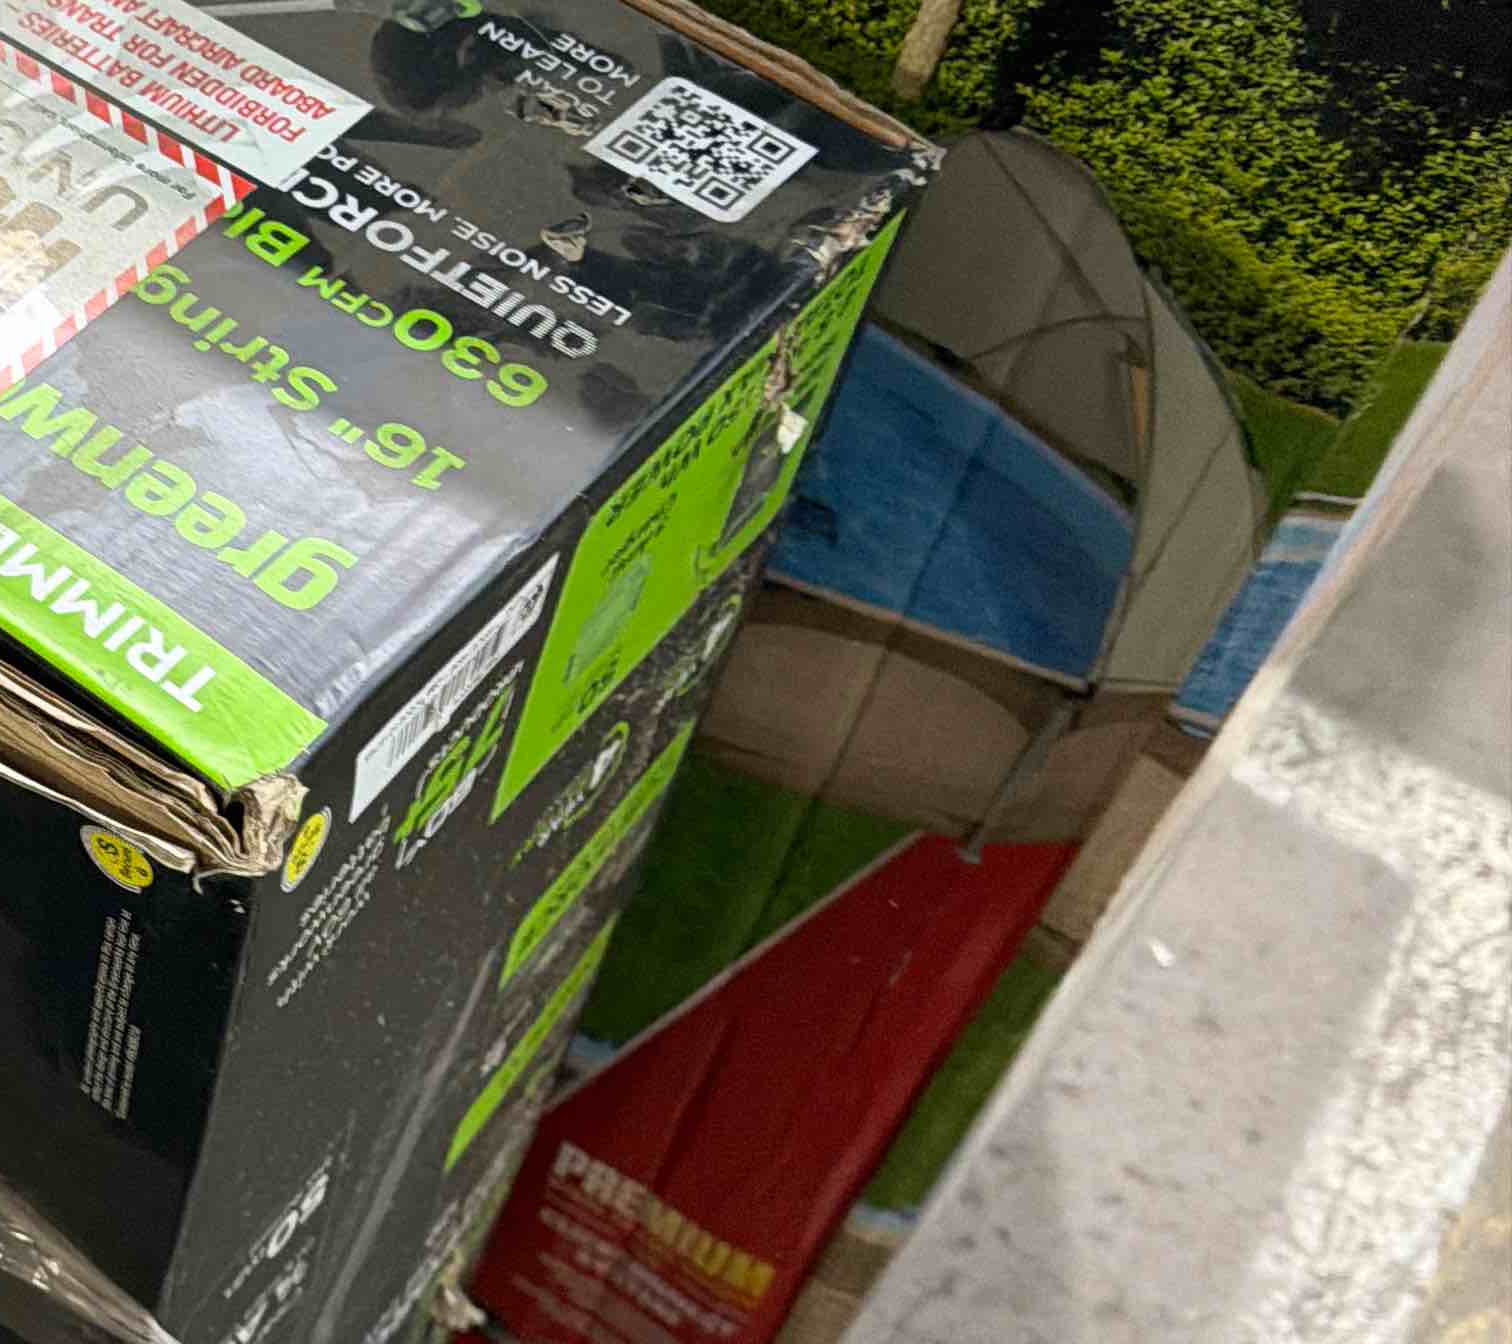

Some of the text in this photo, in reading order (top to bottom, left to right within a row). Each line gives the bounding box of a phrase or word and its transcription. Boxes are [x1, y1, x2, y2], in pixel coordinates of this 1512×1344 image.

[122, 33, 173, 70] FOR
[135, 5, 245, 71] AIRCRAFT
[478, 19, 615, 105] TO LEARN
[550, 31, 640, 88] MORE
[19, 9, 239, 142] LITHIUM BATTERIES
[168, 56, 305, 141] FORBIDDEN
[240, 63, 335, 118] ABOARD
[352, 163, 447, 222] MORE
[450, 215, 551, 280] NOISE.
[549, 273, 631, 325] LESS
[132, 261, 337, 413] String
